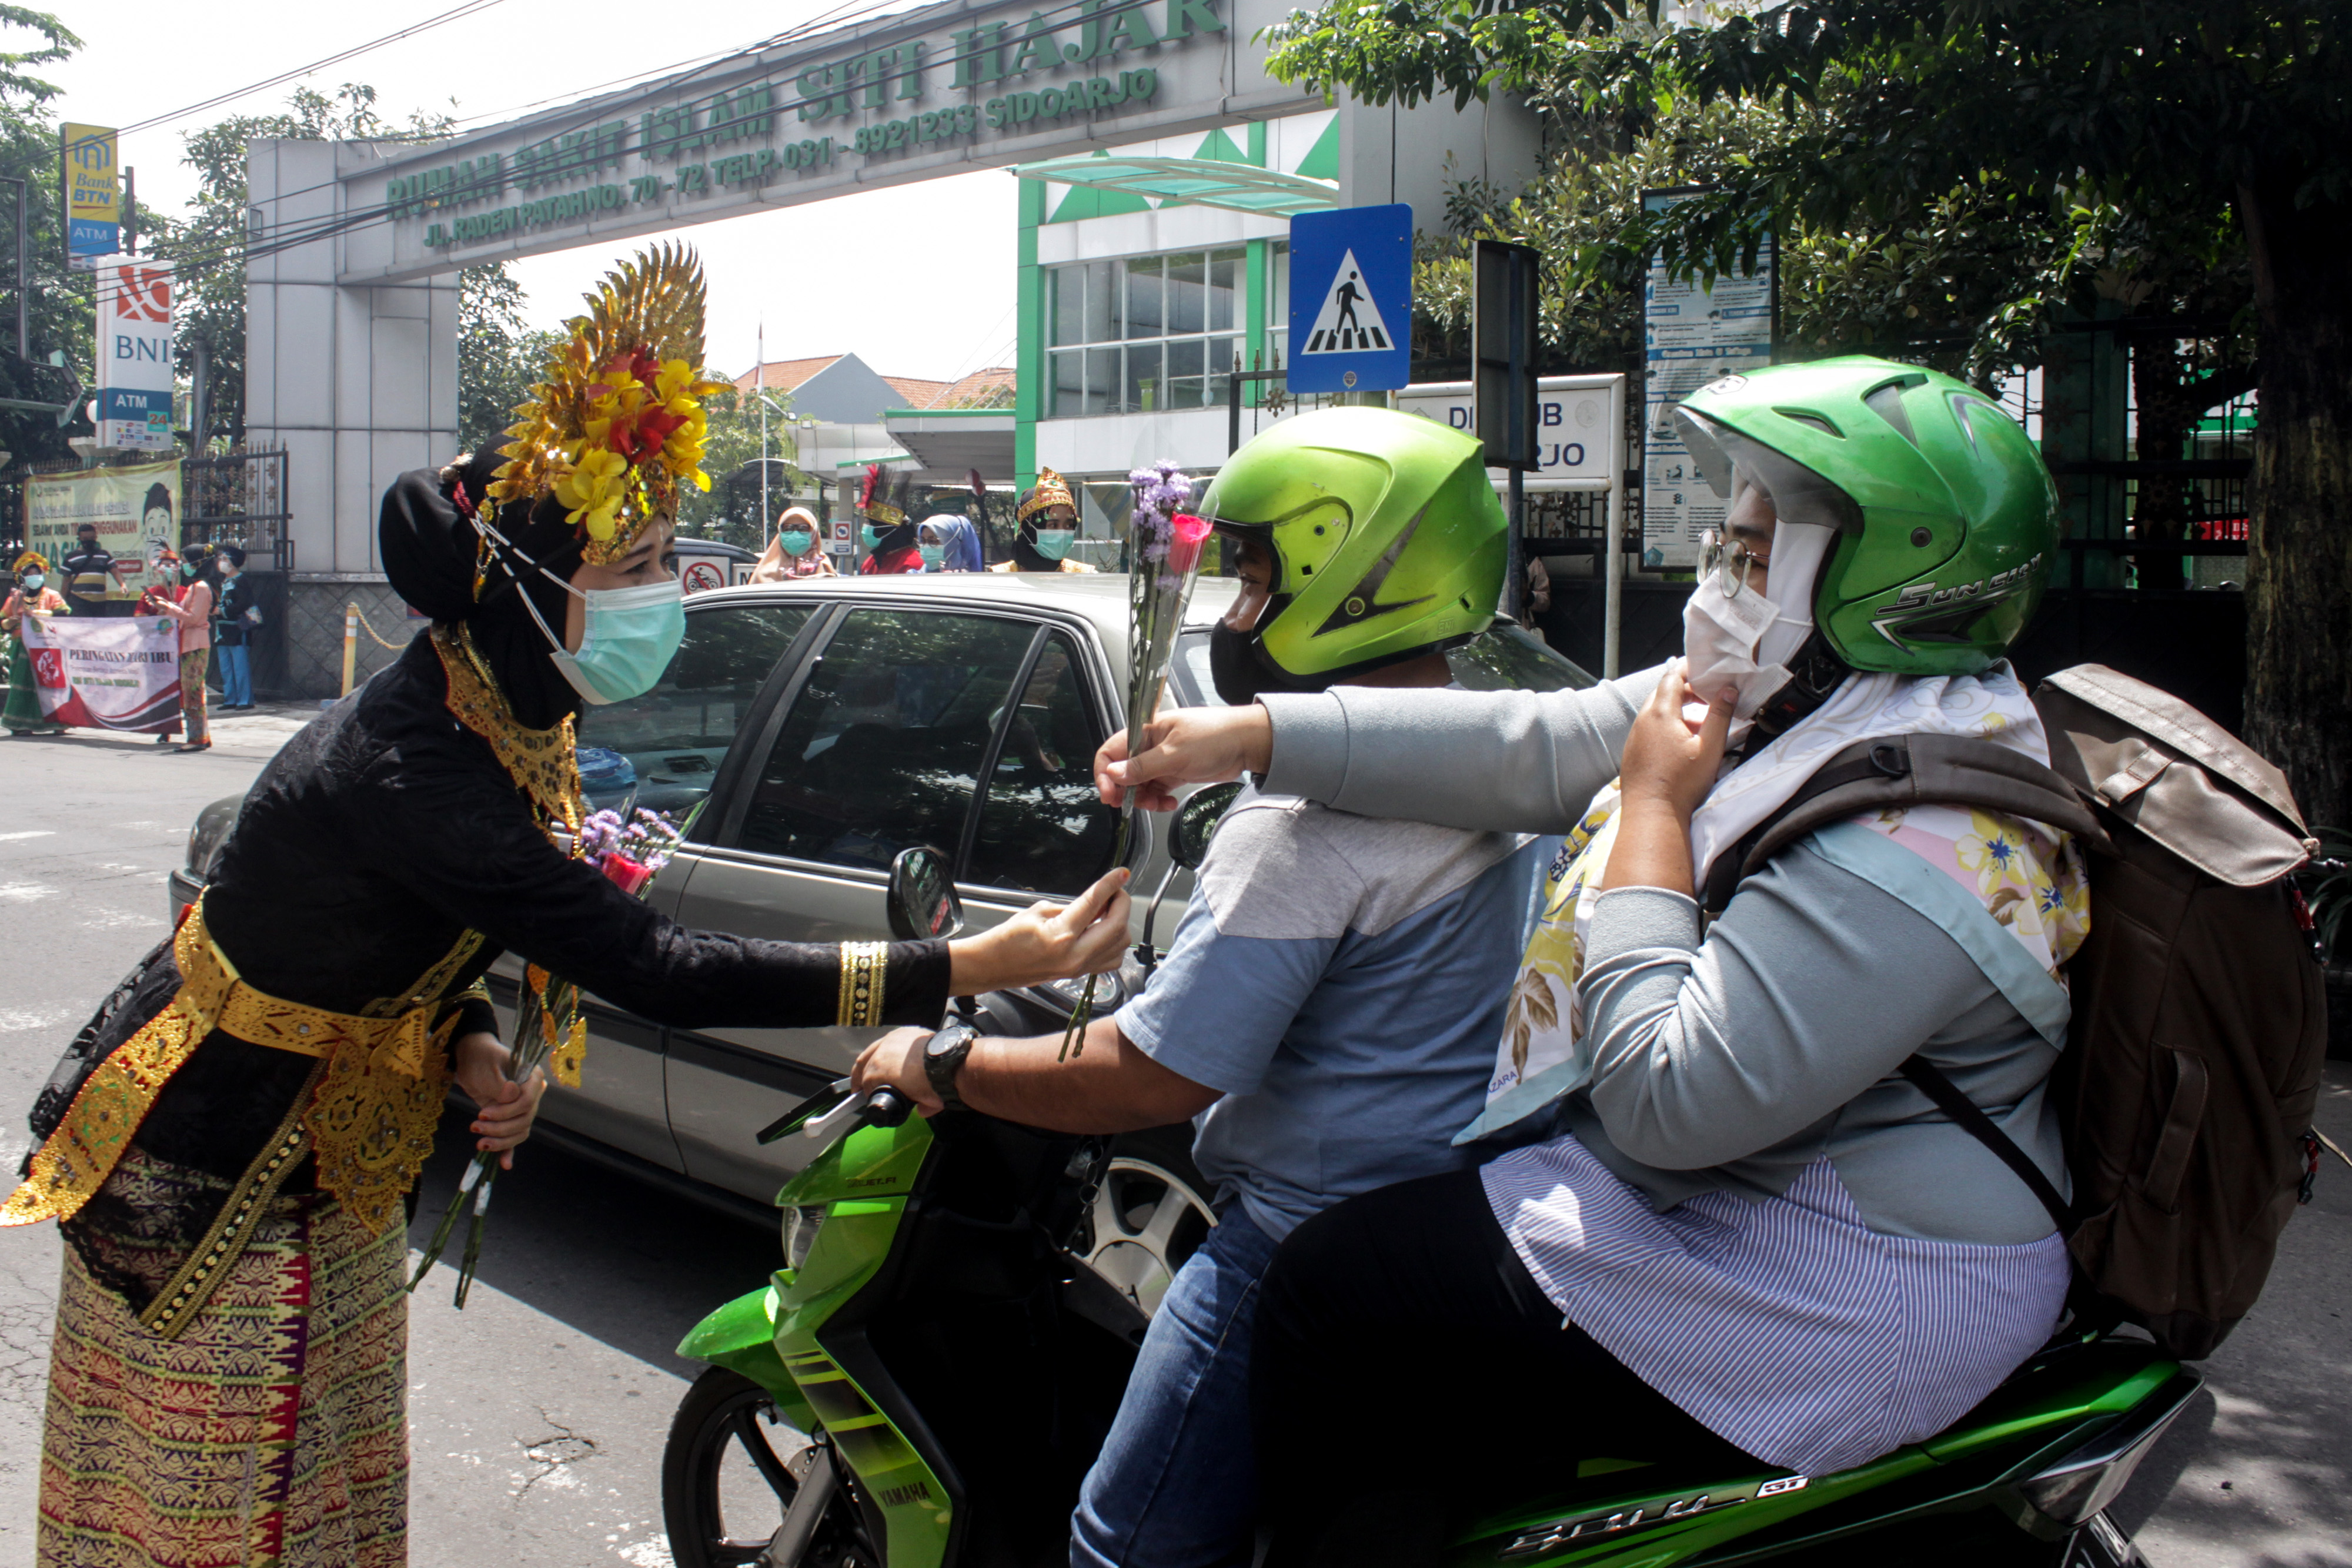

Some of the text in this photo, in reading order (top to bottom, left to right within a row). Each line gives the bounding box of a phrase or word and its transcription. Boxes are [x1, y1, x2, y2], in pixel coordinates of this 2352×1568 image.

[513, 120, 627, 190] SAKIT
[640, 83, 773, 159] ISLAM
[795, 40, 926, 123] SITI
[453, 206, 517, 240] RADEN
[520, 190, 585, 227] PATAH
[629, 175, 657, 203] 70
[676, 163, 704, 193] 72
[783, 138, 831, 170] 031
[854, 105, 977, 155] 8921233
[985, 68, 1157, 129] SIDOARJO
[75, 173, 115, 190] Bank
[73, 189, 111, 205] BTN
[73, 226, 108, 240] ATM
[116, 335, 169, 363] BNI
[116, 394, 147, 409] ATM
[149, 413, 167, 425] 24
[69, 649, 125, 663] PERINGATAN
[151, 651, 174, 663] IBU
[878, 1482, 930, 1507] YAMAHA
